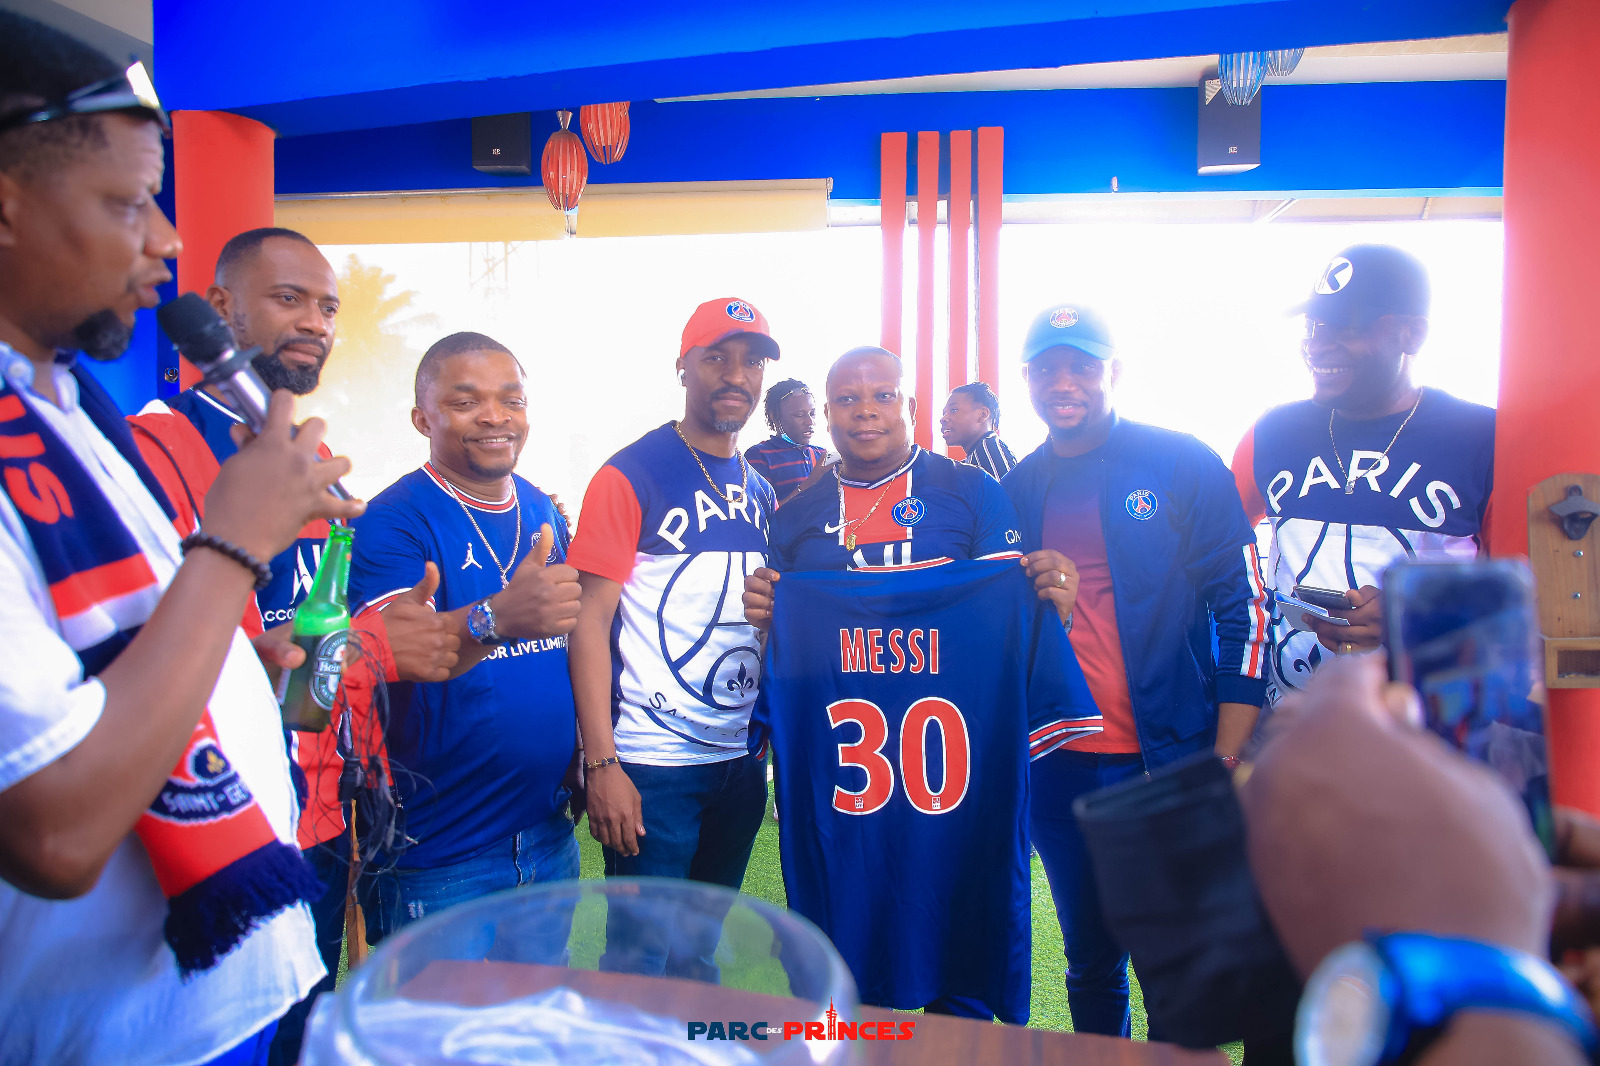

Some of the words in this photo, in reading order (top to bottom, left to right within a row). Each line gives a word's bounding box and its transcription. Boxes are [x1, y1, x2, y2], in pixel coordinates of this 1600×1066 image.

[0, 394, 74, 524] IS
[1267, 449, 1461, 528] PARIS
[656, 483, 769, 552] PARI
[510, 640, 540, 657] LIVE
[839, 627, 939, 674] MESSI
[826, 696, 971, 816] 30
